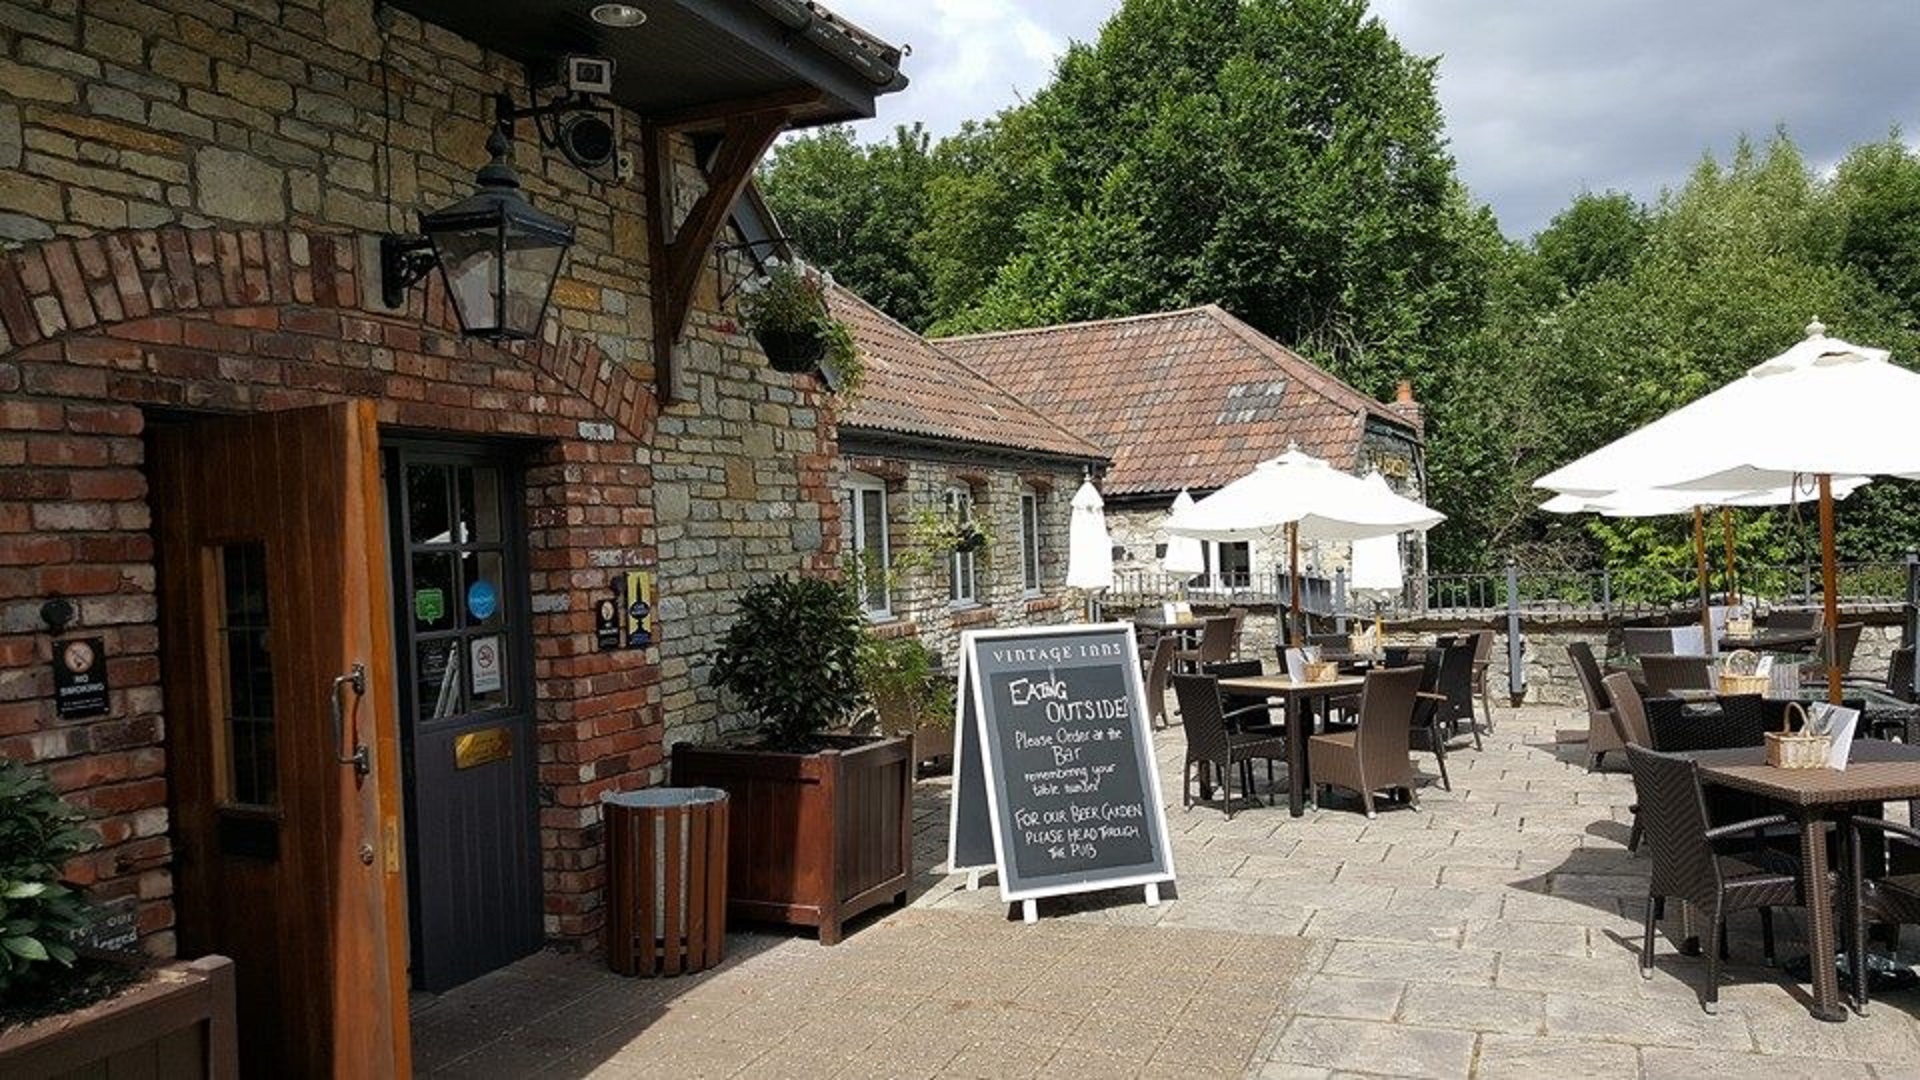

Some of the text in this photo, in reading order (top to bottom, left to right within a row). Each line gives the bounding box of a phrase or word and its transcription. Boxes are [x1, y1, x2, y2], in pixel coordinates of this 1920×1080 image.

[993, 643, 1121, 662] VINTAGE INNS
[75, 674, 89, 683] NO
[60, 683, 105, 696] SMOKING
[1015, 730, 1053, 750] Please
[1056, 727, 1091, 744] Order
[1092, 729, 1104, 741] at
[1051, 745, 1081, 766] Bar
[1024, 763, 1116, 785] remembering your
[1033, 784, 1060, 797] table
[1015, 801, 1142, 830] FOR OUR BEER GARDEN
[1025, 830, 1065, 845] PLEASE
[1067, 828, 1098, 843] HEAD
[1070, 843, 1097, 859] PUB
